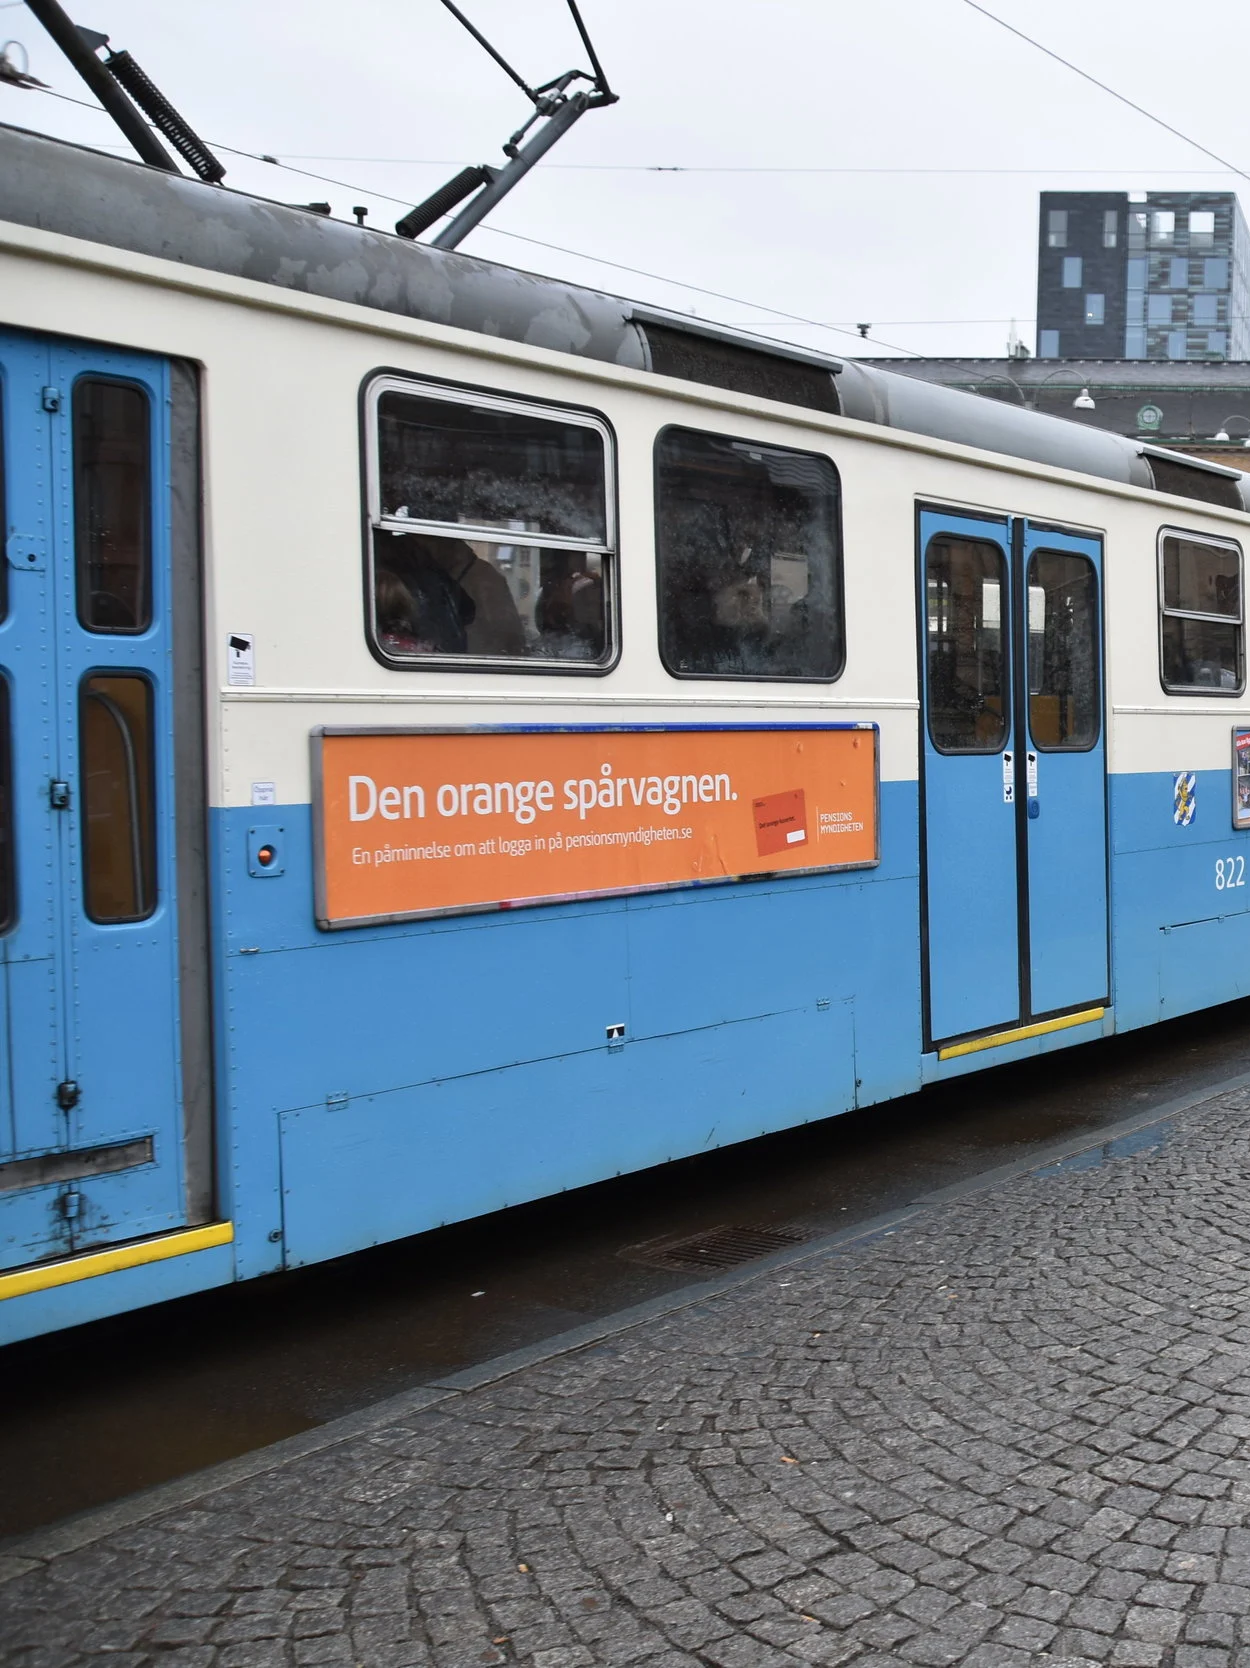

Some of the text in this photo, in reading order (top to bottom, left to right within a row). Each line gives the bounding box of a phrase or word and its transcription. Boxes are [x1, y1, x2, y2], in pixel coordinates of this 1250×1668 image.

[348, 763, 738, 825] Den orange spårvagnen.
[820, 812, 853, 823] PENSIONS
[820, 822, 864, 835] MYNDIGHETEN
[352, 826, 693, 868] En påminnelse om att logga in på pensionsmyndigheten.se
[1215, 855, 1246, 891] 822
